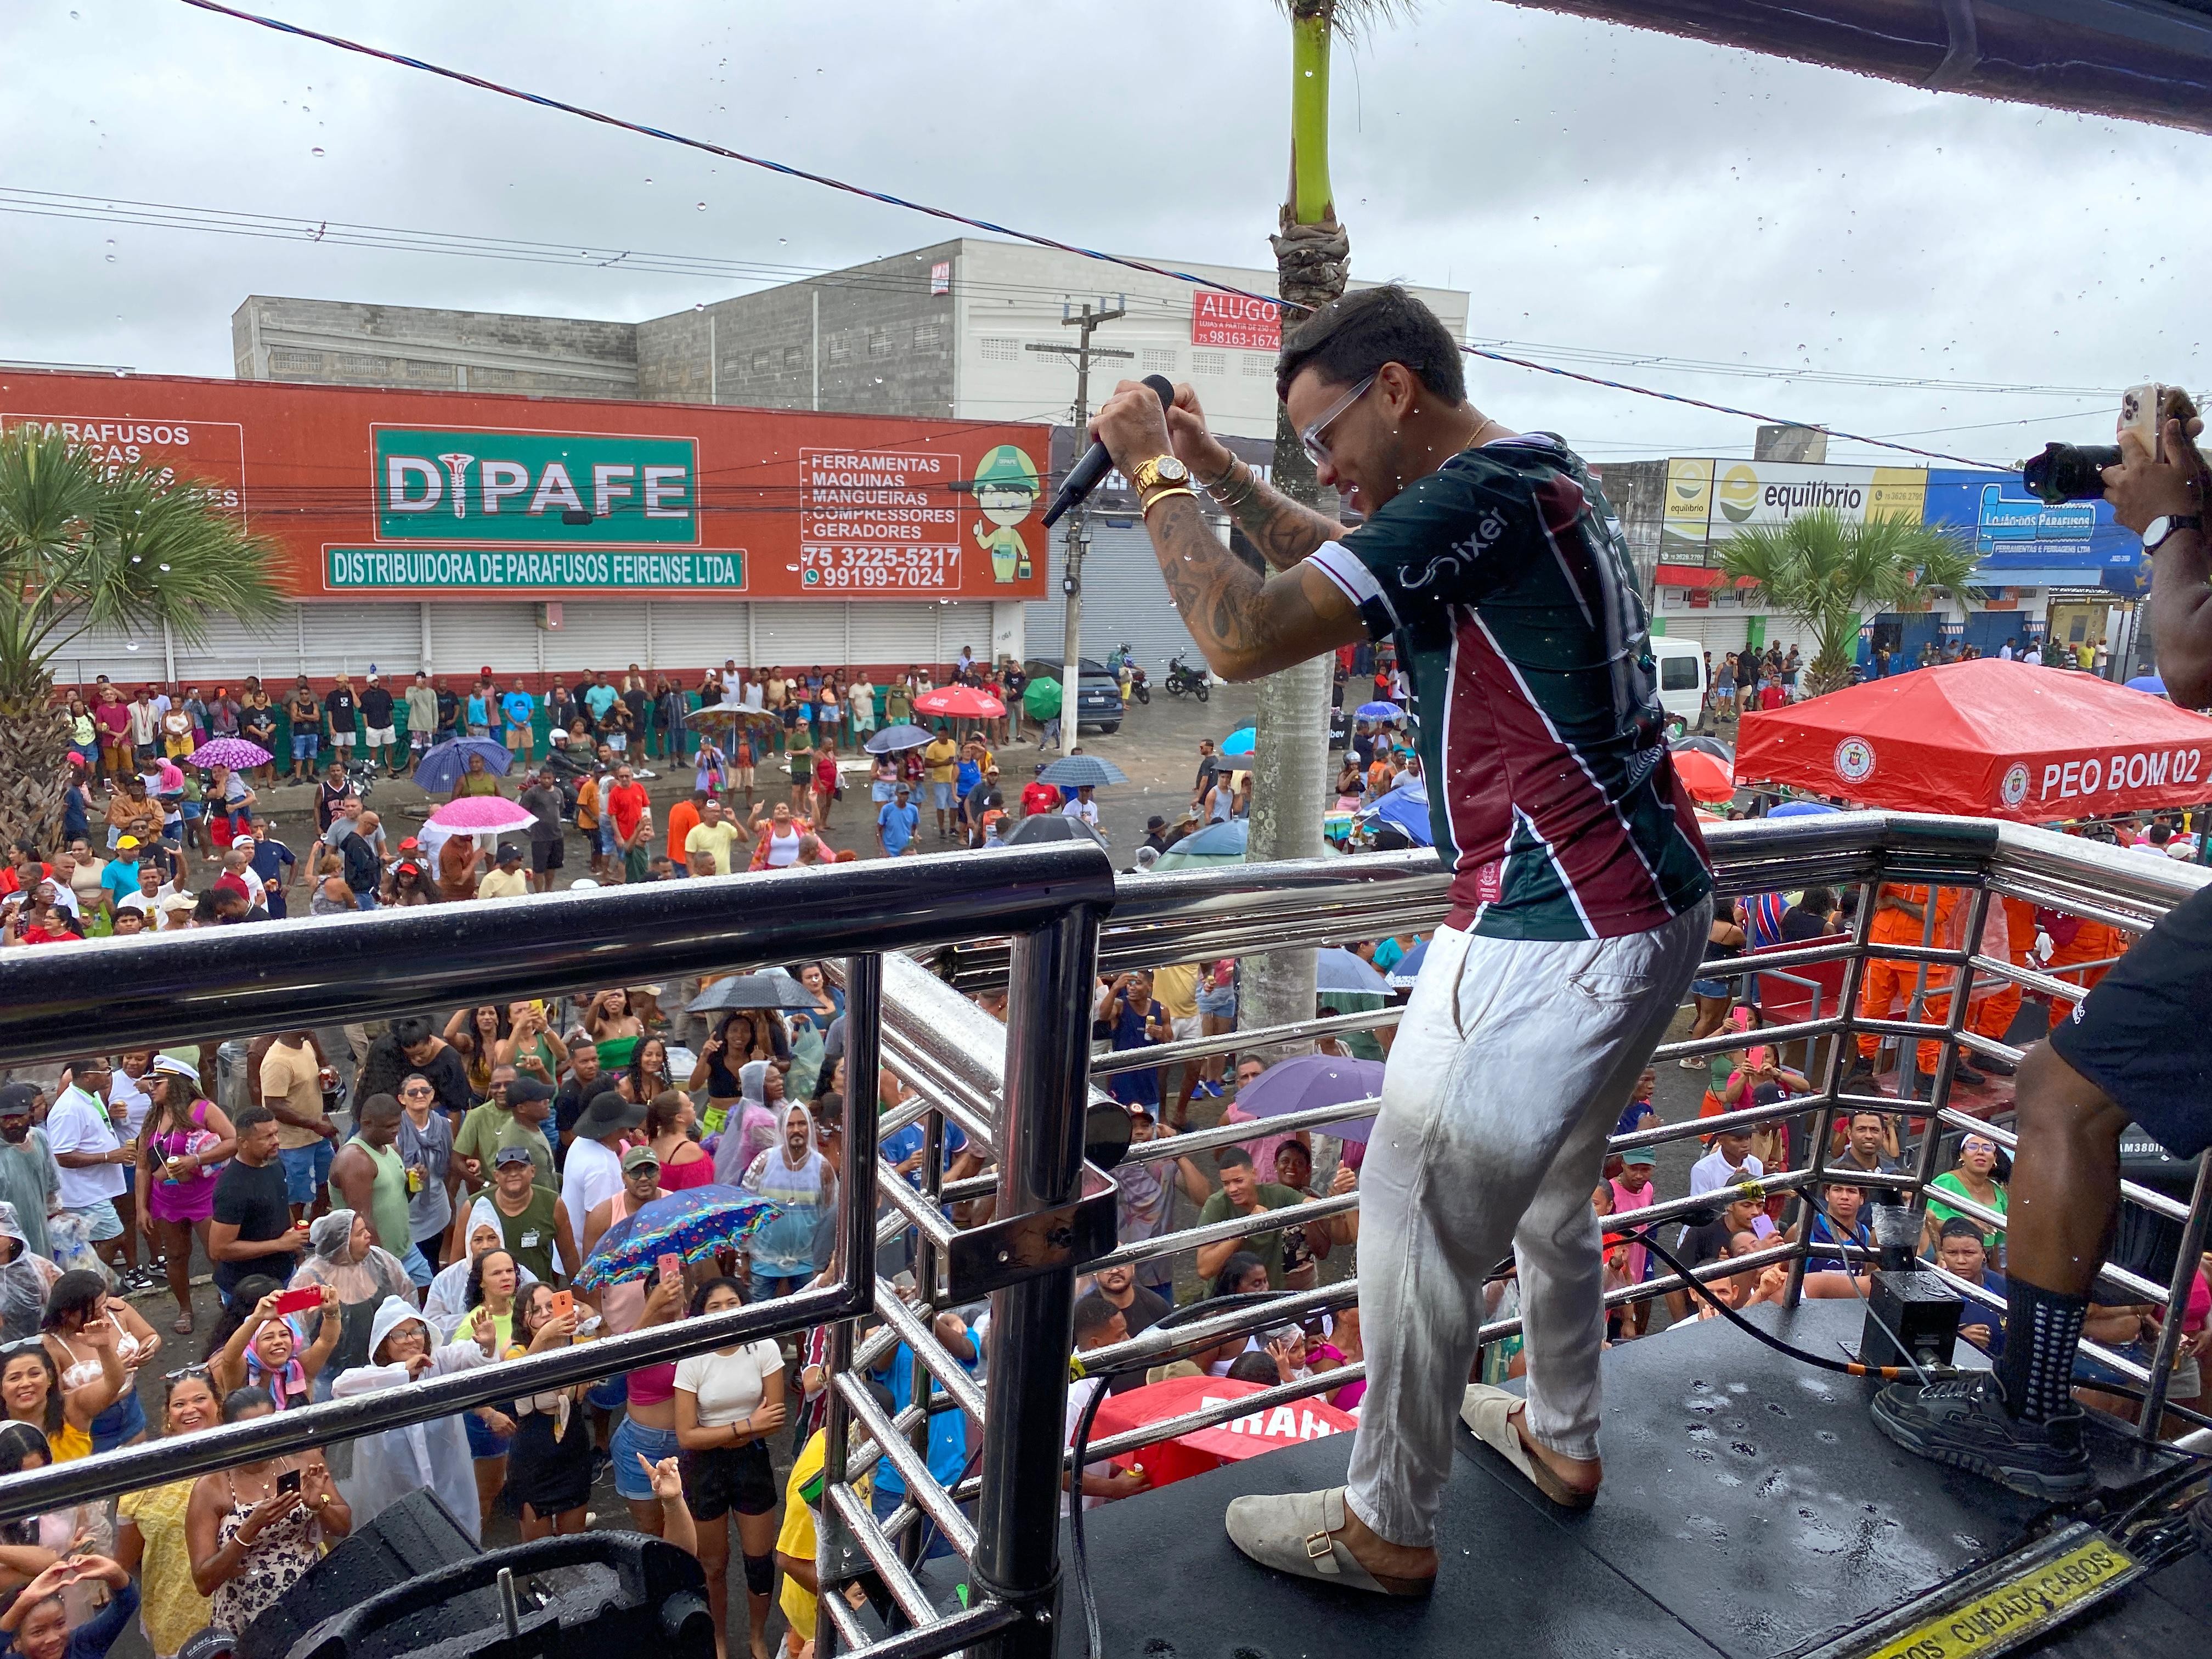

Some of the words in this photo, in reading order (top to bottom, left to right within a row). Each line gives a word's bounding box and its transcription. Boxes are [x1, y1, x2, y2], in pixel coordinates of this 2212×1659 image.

[1201, 295, 1277, 322] ALUGO
[1199, 333, 1207, 342] 75
[1210, 330, 1279, 347] 98163-1674
[812, 455, 940, 473] FERRAMENTAS
[812, 473, 905, 487] MAQUINAS
[812, 490, 928, 506] MANGUEIRAS
[1764, 480, 1861, 518] equilíbrio
[812, 507, 955, 523] COMPRESSORES
[813, 523, 922, 539] GERADORES
[803, 548, 832, 566] 75
[841, 548, 960, 566] 3225-5217
[335, 552, 476, 583] DISTRIBUIDORA
[481, 554, 503, 583] DE
[506, 555, 608, 584] PARAFUSOS
[613, 555, 691, 584] FEIRENSE
[696, 556, 736, 584] LTDA
[824, 567, 944, 586] 99199-7024
[1330, 729, 1345, 738] bev
[2040, 759, 2102, 801] PEO
[2107, 751, 2169, 791] BOM
[2172, 749, 2201, 783] 02
